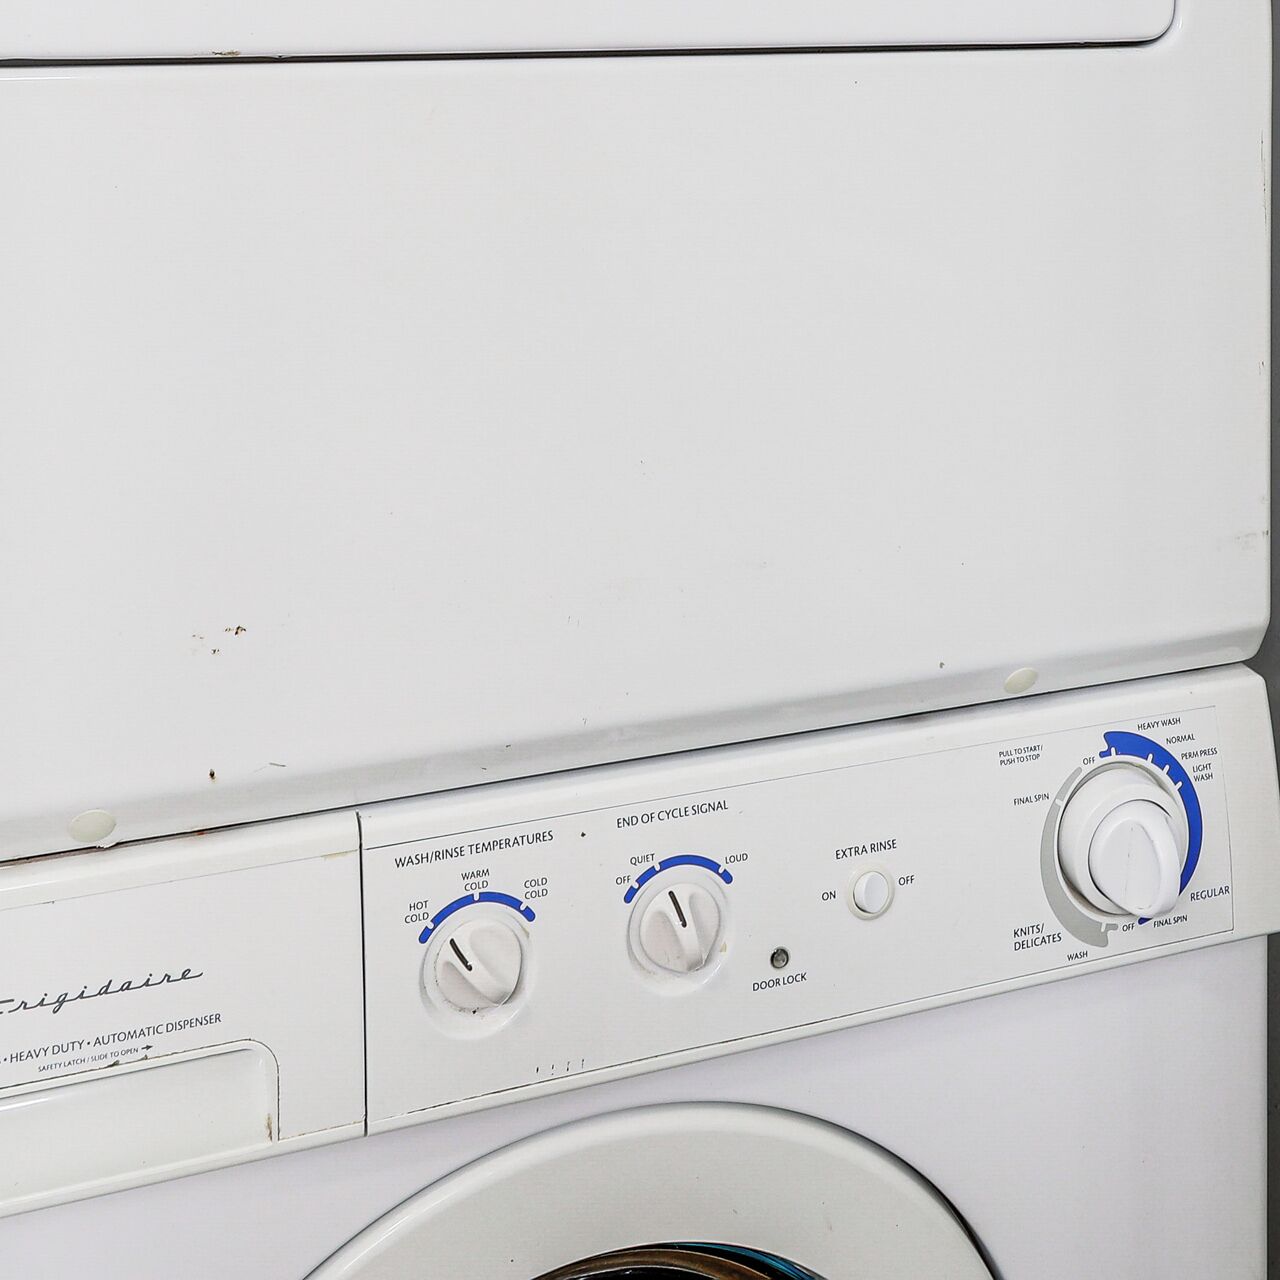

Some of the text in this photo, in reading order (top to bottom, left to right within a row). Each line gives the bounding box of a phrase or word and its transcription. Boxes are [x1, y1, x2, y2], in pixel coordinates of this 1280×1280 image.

[1137, 717, 1181, 731] HEAVY WASH
[1166, 733, 1195, 745] NORMAL
[999, 750, 1013, 758] PULL
[1014, 747, 1023, 755] TO
[1181, 747, 1218, 760] PERM PRESS
[1000, 758, 1016, 766] PUSH
[1025, 753, 1040, 762] STOP
[1082, 756, 1095, 765] OFF
[1192, 763, 1212, 773] LIGHT
[1194, 772, 1213, 782] WASH
[1013, 792, 1050, 806] FINAL SPIN
[616, 800, 729, 829] END OF CYCLE SIGNAL
[394, 830, 554, 869] WASH/RINSE TEMPERATURES
[835, 839, 897, 860] EXTRA RINSE
[629, 853, 655, 866] QUIET
[724, 853, 748, 865] LOUD
[461, 868, 490, 881] WARM
[615, 875, 632, 886] OFF
[464, 880, 489, 892] COLD
[524, 877, 548, 889] COLD
[898, 875, 915, 887] OFF
[524, 888, 549, 900] COLD
[821, 890, 837, 902] ON
[1190, 885, 1230, 902] REGULAR
[409, 900, 429, 912] HOT
[404, 912, 429, 924] COLD
[1153, 914, 1188, 928] FINAL SPIN
[1013, 923, 1044, 938] KNITS/
[1122, 923, 1135, 932] OFF
[1014, 932, 1062, 951] DELICATES
[1066, 950, 1088, 961] WASH
[752, 972, 807, 992] DOOR LOCK
[10, 1048, 50, 1064] HEAVY
[52, 1039, 85, 1056] DUTY
[93, 1024, 164, 1048] AUTOMATIC
[165, 1013, 222, 1033] DISPENSER
[38, 1062, 63, 1073] SAFETY
[63, 1058, 86, 1067] LATCH
[110, 1050, 119, 1058] TO
[120, 1048, 139, 1056] OPEN
